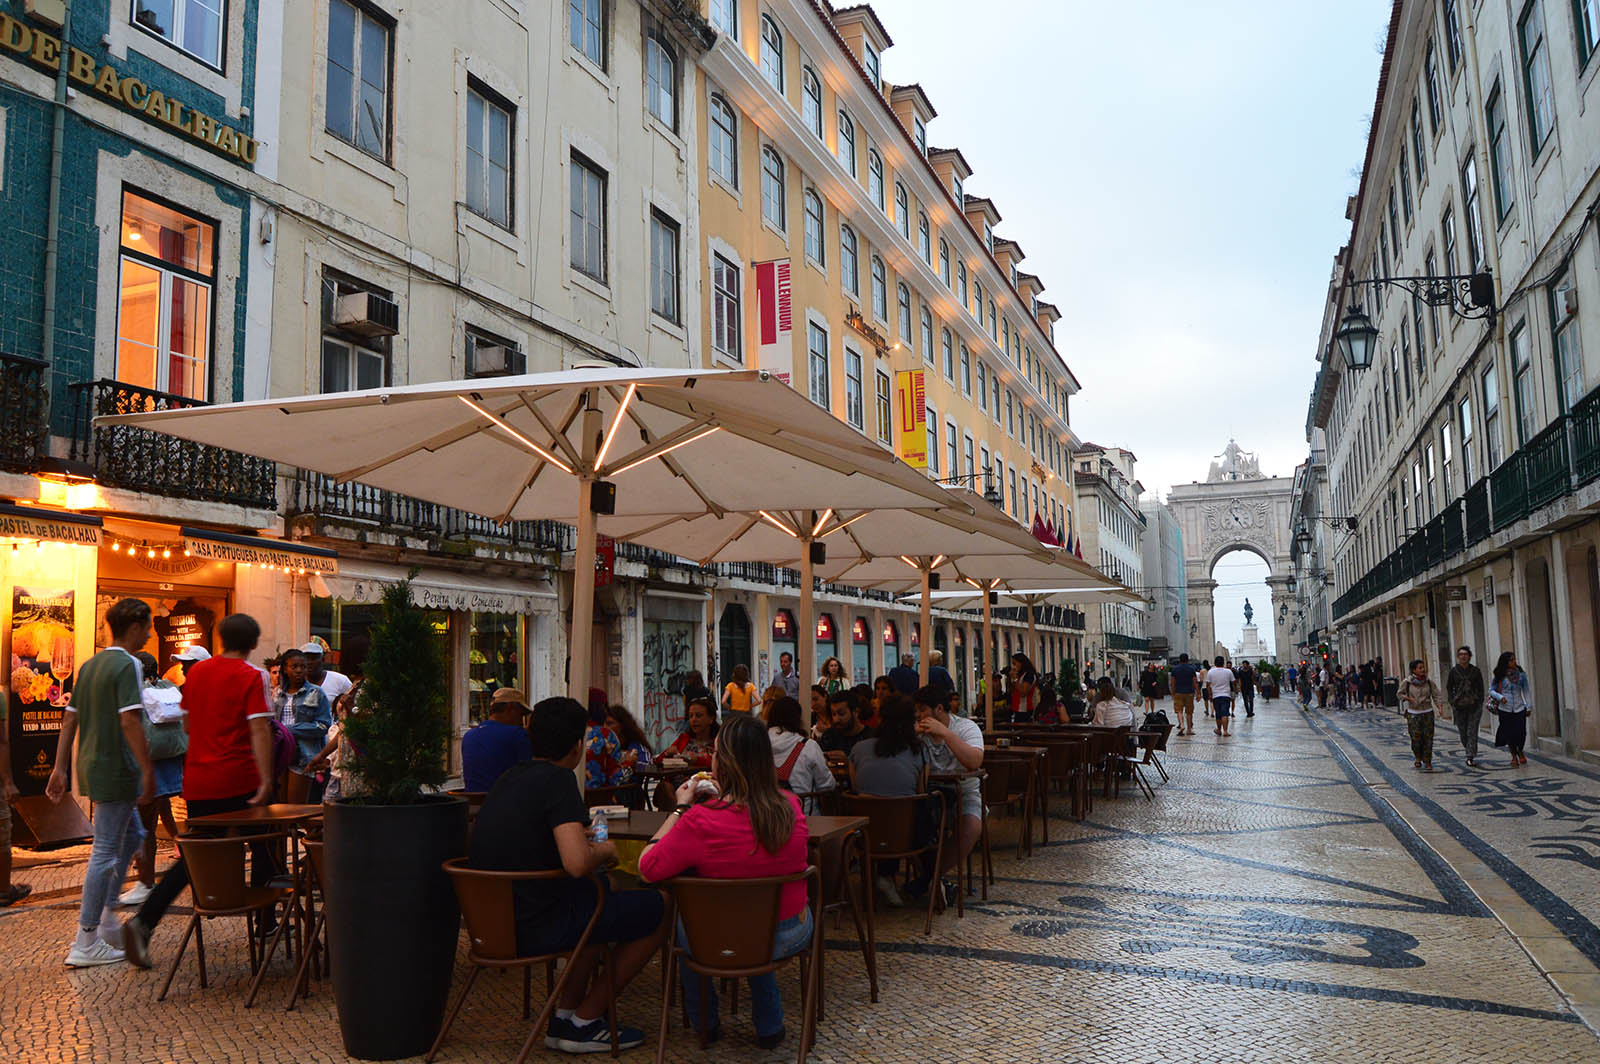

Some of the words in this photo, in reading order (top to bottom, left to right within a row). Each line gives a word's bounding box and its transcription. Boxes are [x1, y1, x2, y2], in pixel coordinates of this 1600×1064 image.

[0, 12, 63, 72] DE
[67, 46, 260, 165] BACALHAU
[777, 263, 792, 332] MILLENNIUM
[915, 373, 926, 423] MILLENNIUM
[0, 518, 34, 536] PASTEL
[35, 524, 48, 537] DE
[48, 524, 97, 544] BACALHAU
[191, 541, 212, 556] CASA
[213, 544, 259, 563] PORTUGUESA
[259, 551, 270, 563] DO
[269, 551, 294, 567] PASTEL
[294, 558, 302, 568] DE
[303, 558, 335, 572] BACALHAU
[22, 711, 37, 721] PASTEL
[22, 722, 39, 732] VINHO
